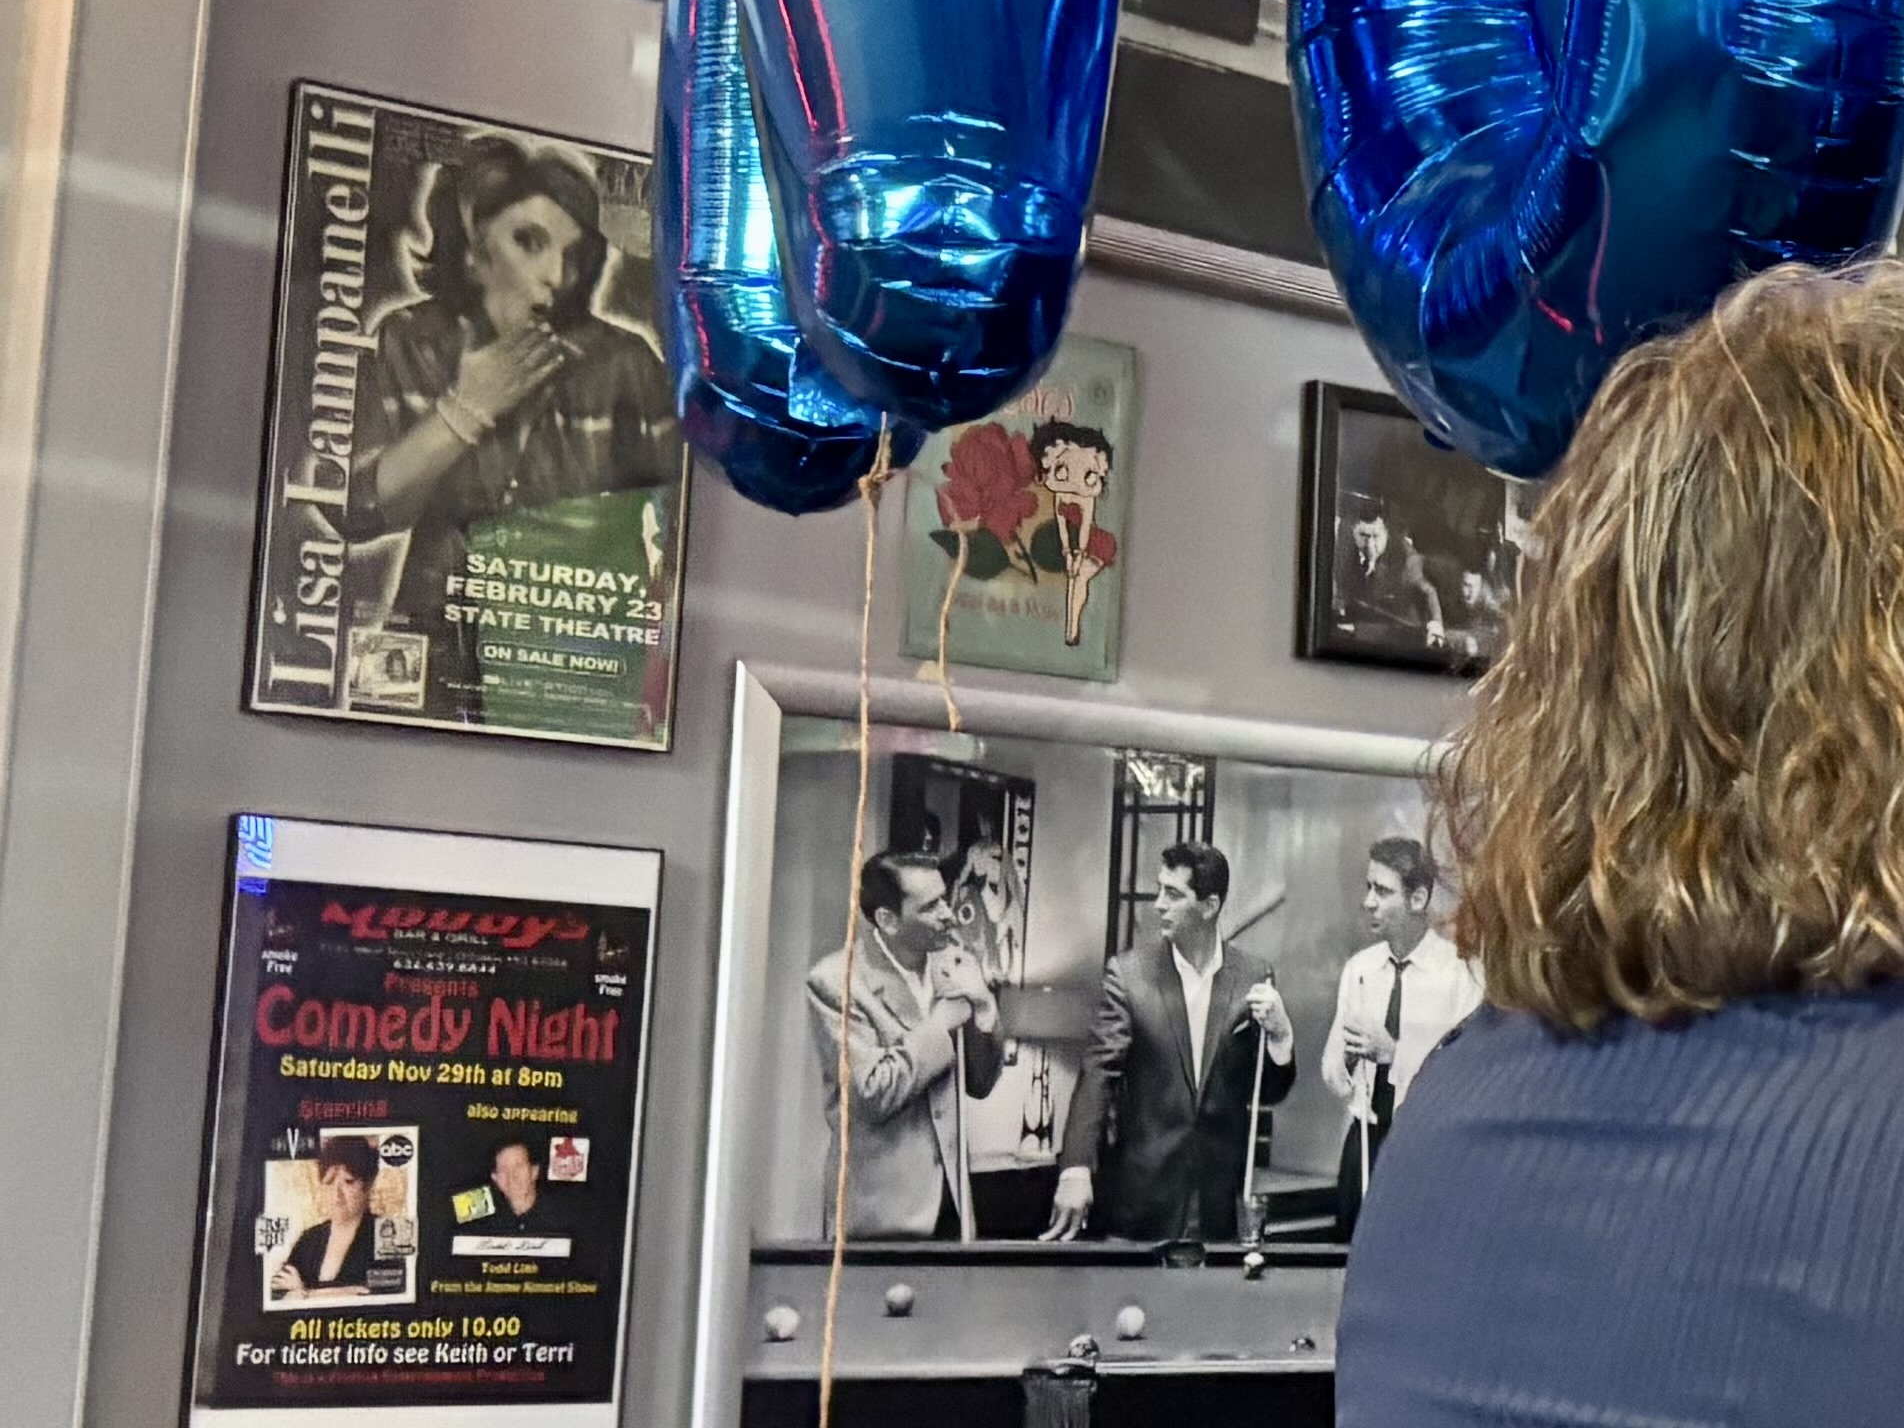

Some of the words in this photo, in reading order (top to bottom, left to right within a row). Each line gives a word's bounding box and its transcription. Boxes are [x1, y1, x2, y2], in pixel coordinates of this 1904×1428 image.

[283, 100, 378, 516] Lampanelli
[467, 553, 647, 599] SATURDAY,
[446, 575, 618, 616] FEBRUARY
[626, 600, 662, 621] 23
[269, 538, 345, 699] Lisa
[444, 604, 531, 631] STATE
[539, 616, 661, 645] THEATRE
[484, 645, 512, 660] ON
[517, 650, 563, 667] SALE
[257, 984, 471, 1053] Comedy
[488, 998, 620, 1061] Night
[280, 1054, 382, 1082] Saturday
[388, 1060, 431, 1082] Nov
[438, 1063, 485, 1085] 29th
[492, 1067, 513, 1085] at
[518, 1067, 563, 1088] 8pm
[468, 1103, 497, 1120] also
[380, 1139, 412, 1156] abc
[290, 1319, 321, 1340] All
[329, 1318, 400, 1339] tickets
[408, 1318, 453, 1340] only
[462, 1317, 520, 1339] 10.00
[237, 1344, 275, 1365] For
[281, 1343, 341, 1364] ticket
[394, 1347, 429, 1363] see
[435, 1342, 488, 1364] Keith
[494, 1346, 517, 1363] or
[523, 1342, 573, 1363] Terri
